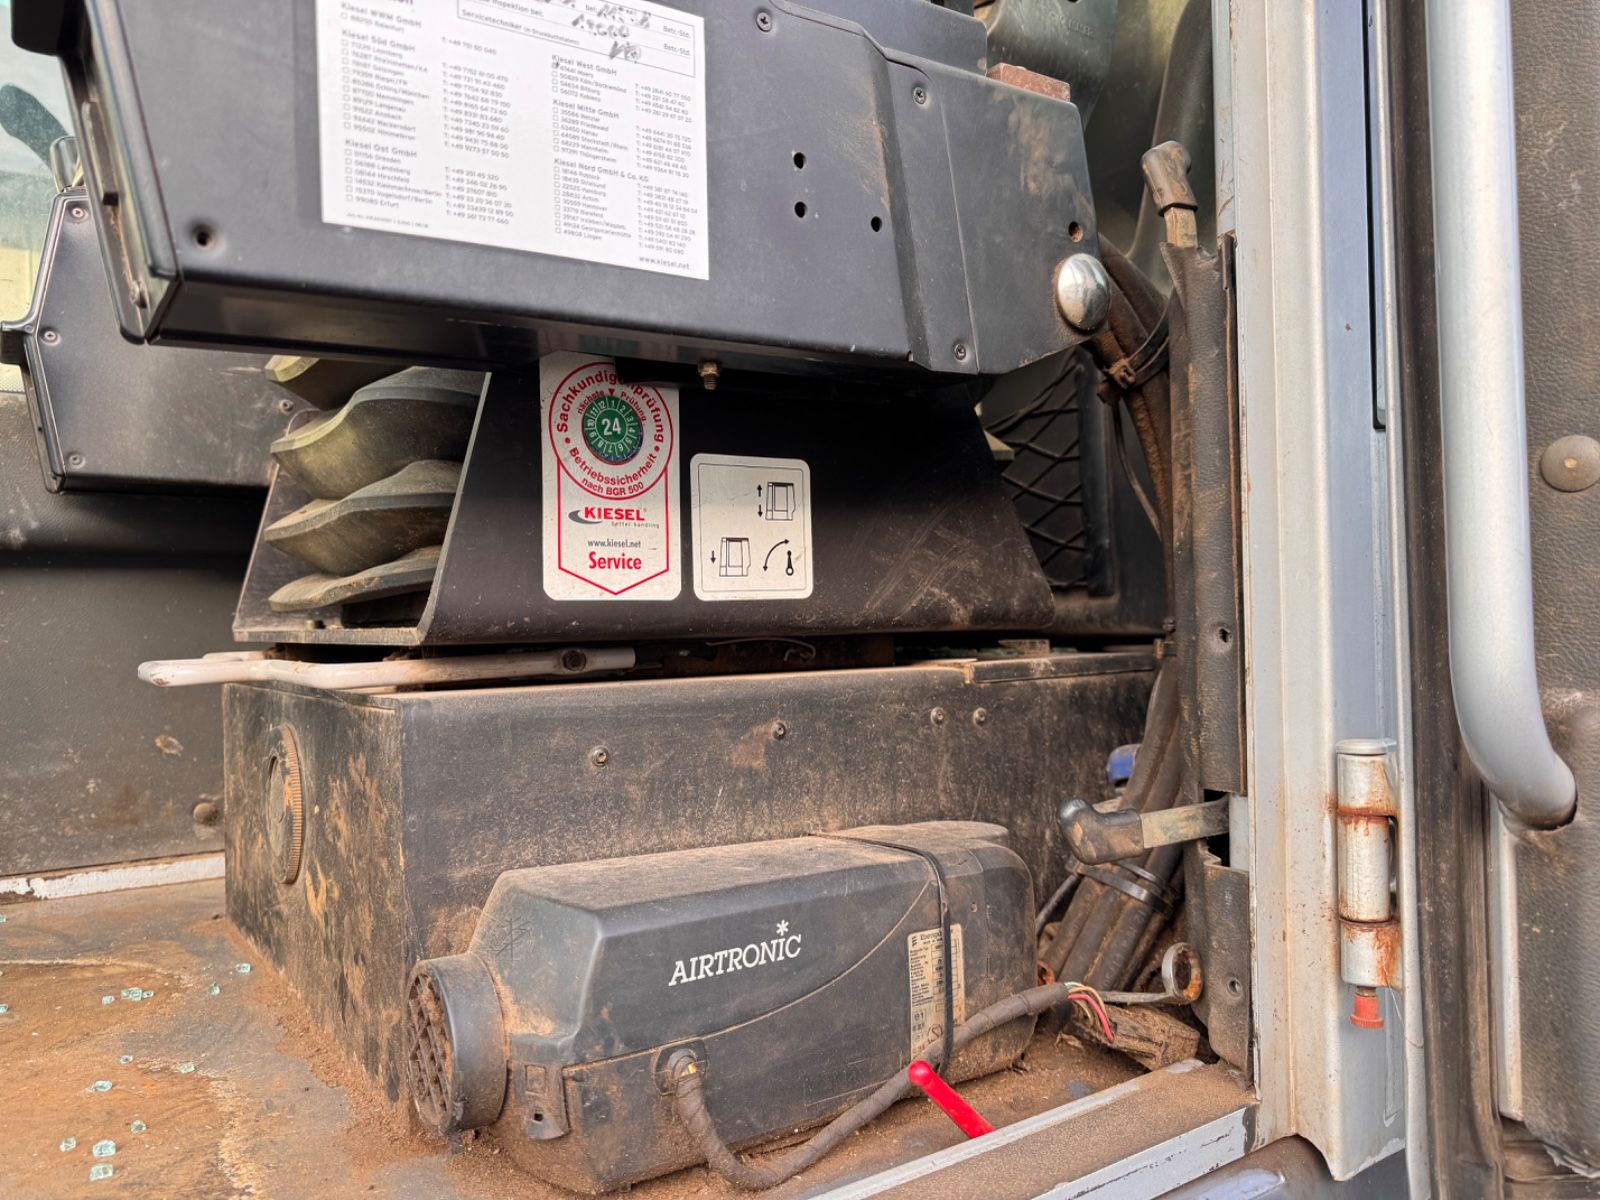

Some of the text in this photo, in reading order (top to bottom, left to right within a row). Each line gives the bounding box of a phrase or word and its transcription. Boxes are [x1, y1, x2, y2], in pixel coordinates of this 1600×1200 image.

[395, 14, 421, 28] GmbH
[341, 28, 368, 41] Kiesel
[389, 39, 415, 52] GmbH
[551, 54, 616, 76] Kiesel West GmbH
[553, 98, 619, 119] Kiesel Mitte GmbH
[345, 138, 416, 158] Kiesel Ost GmbH
[554, 157, 576, 168] Kiesel
[578, 162, 594, 171] Nord
[597, 166, 617, 176] GmbH
[627, 172, 636, 180] Co.
[639, 174, 648, 182] KG
[380, 199, 399, 208] Erfurt
[639, 256, 688, 269] www.kiesel.net
[556, 370, 664, 443] Sachkundigprüfung
[601, 417, 622, 436] 24
[570, 447, 657, 486] Betriebssicherheit
[582, 478, 644, 496] nach BGR 500
[588, 538, 641, 548] www.kiesel.net
[589, 551, 642, 570] Service
[668, 933, 801, 986] AIRTRONIC
